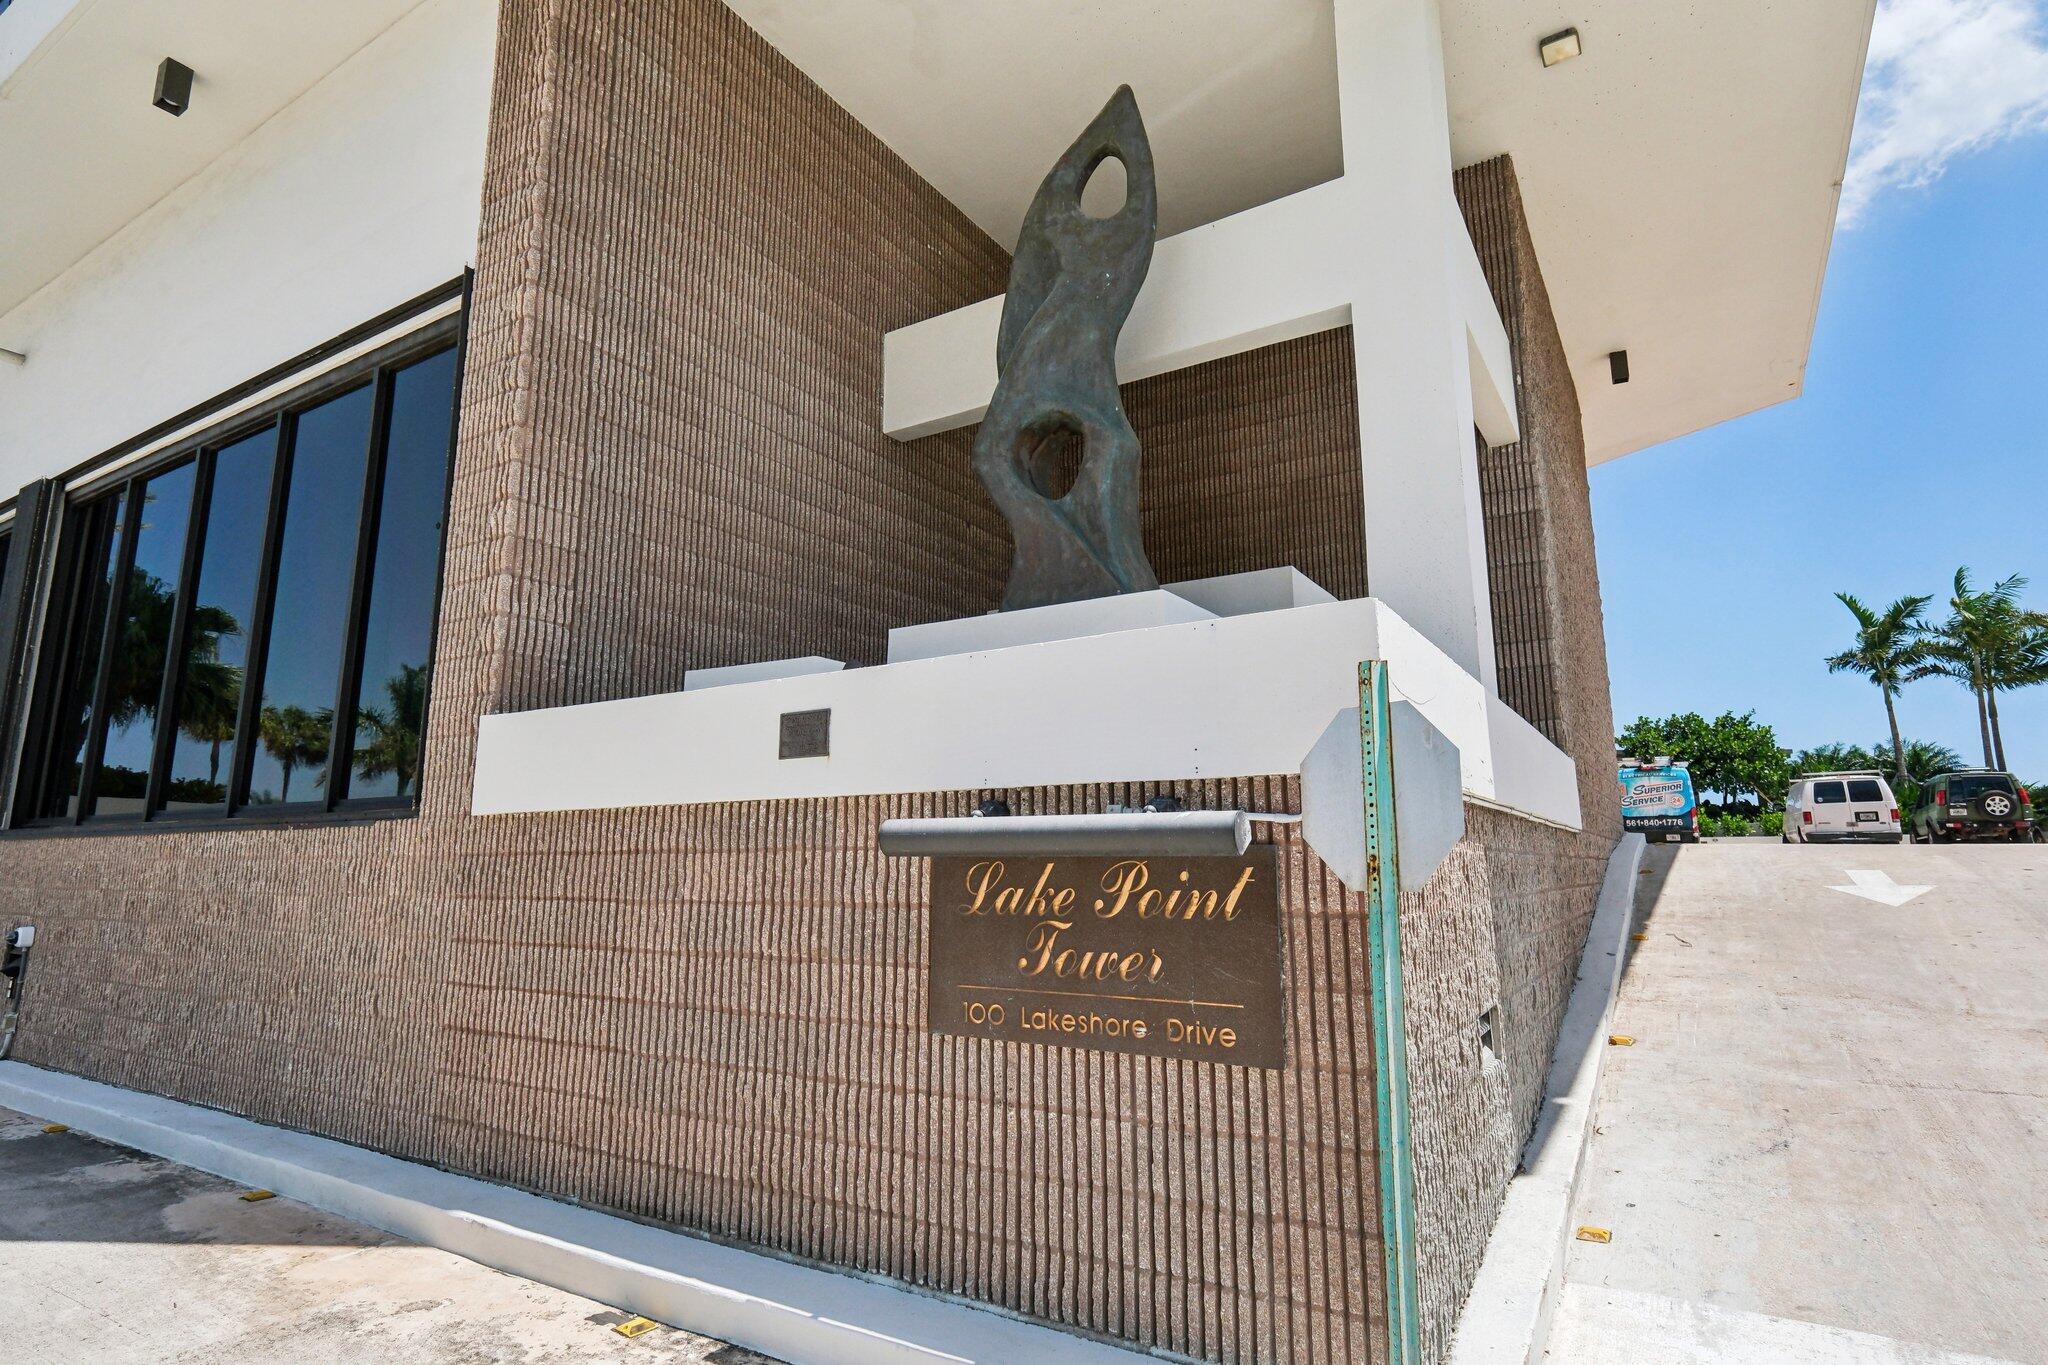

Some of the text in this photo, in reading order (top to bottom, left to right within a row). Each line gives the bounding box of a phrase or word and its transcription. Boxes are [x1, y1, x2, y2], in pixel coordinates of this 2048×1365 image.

[1622, 796, 1664, 806] SERVICE
[1633, 784, 1682, 795] SUPERIOR
[959, 860, 1255, 921] Lake Point
[1018, 920, 1166, 983] Tower
[962, 1002, 1237, 1047] 100 Lakeshore Drive
